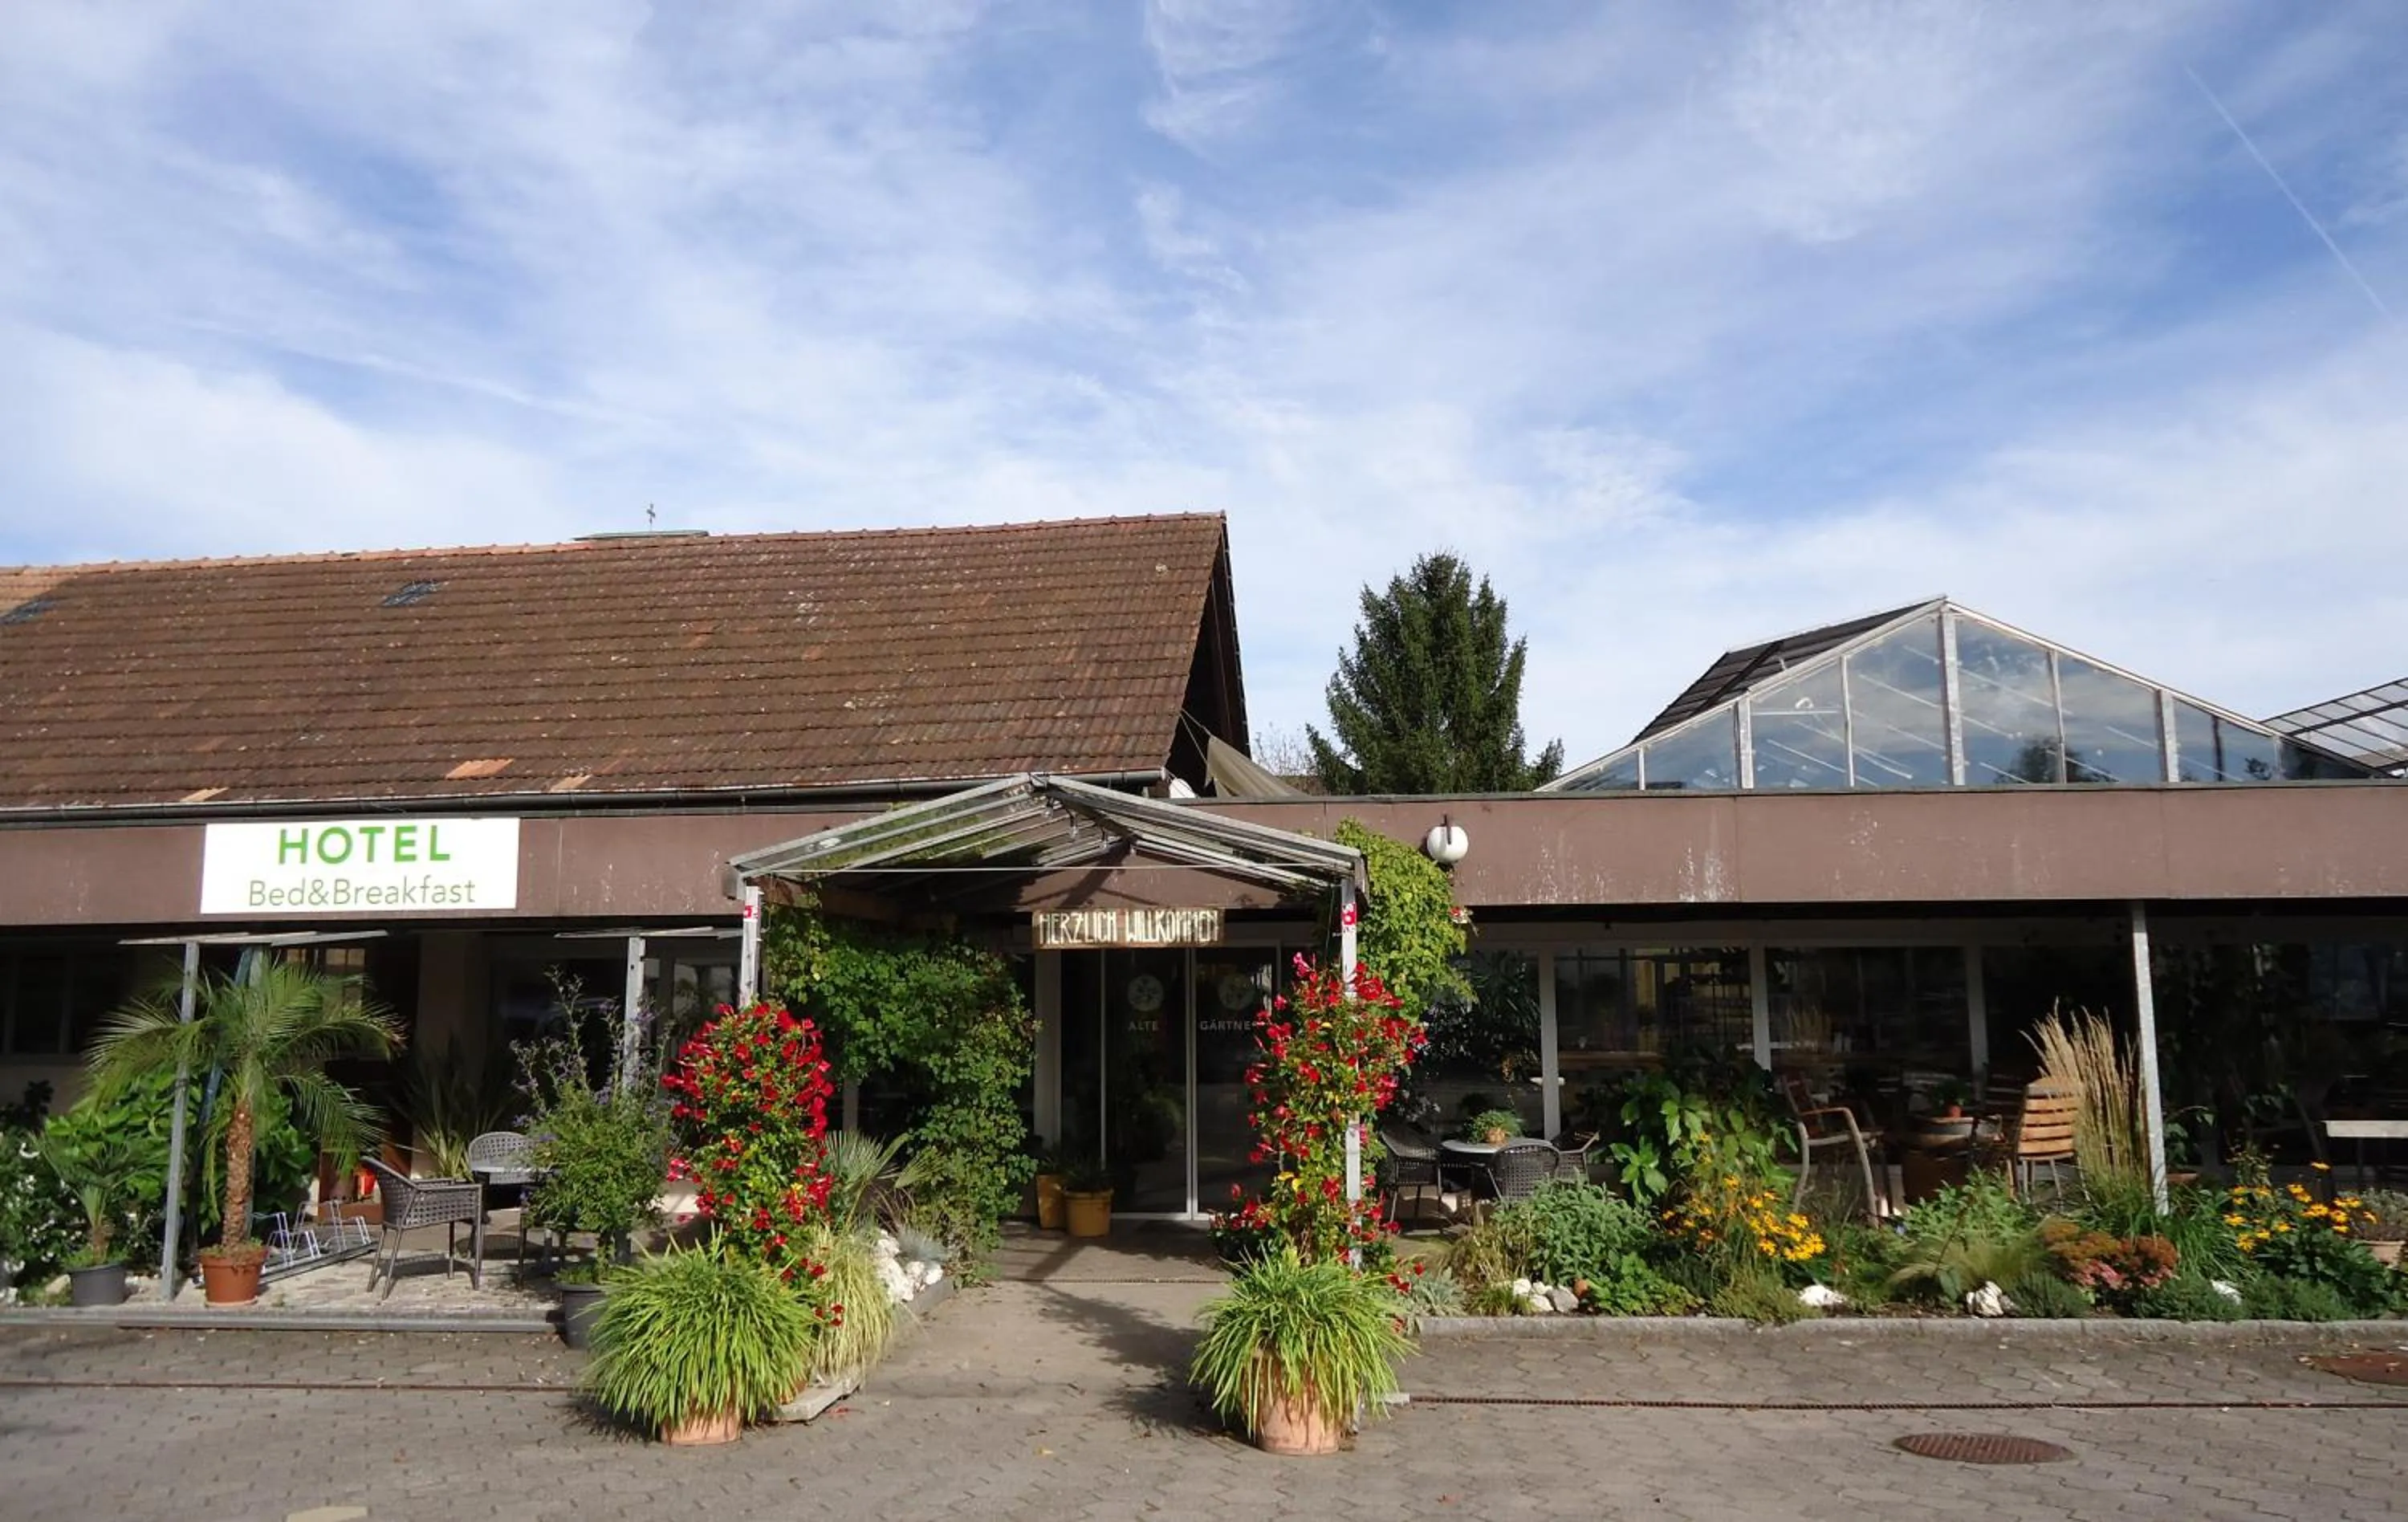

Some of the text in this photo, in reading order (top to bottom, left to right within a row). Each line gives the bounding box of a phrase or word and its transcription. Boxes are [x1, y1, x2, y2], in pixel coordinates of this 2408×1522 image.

[279, 824, 451, 865] HOTEL
[248, 875, 477, 907] Bed&Breakfast
[1039, 910, 1219, 945] HERZLICH WILLKOMMEN
[1128, 1018, 1252, 1032] ALTE GÄRTNE
